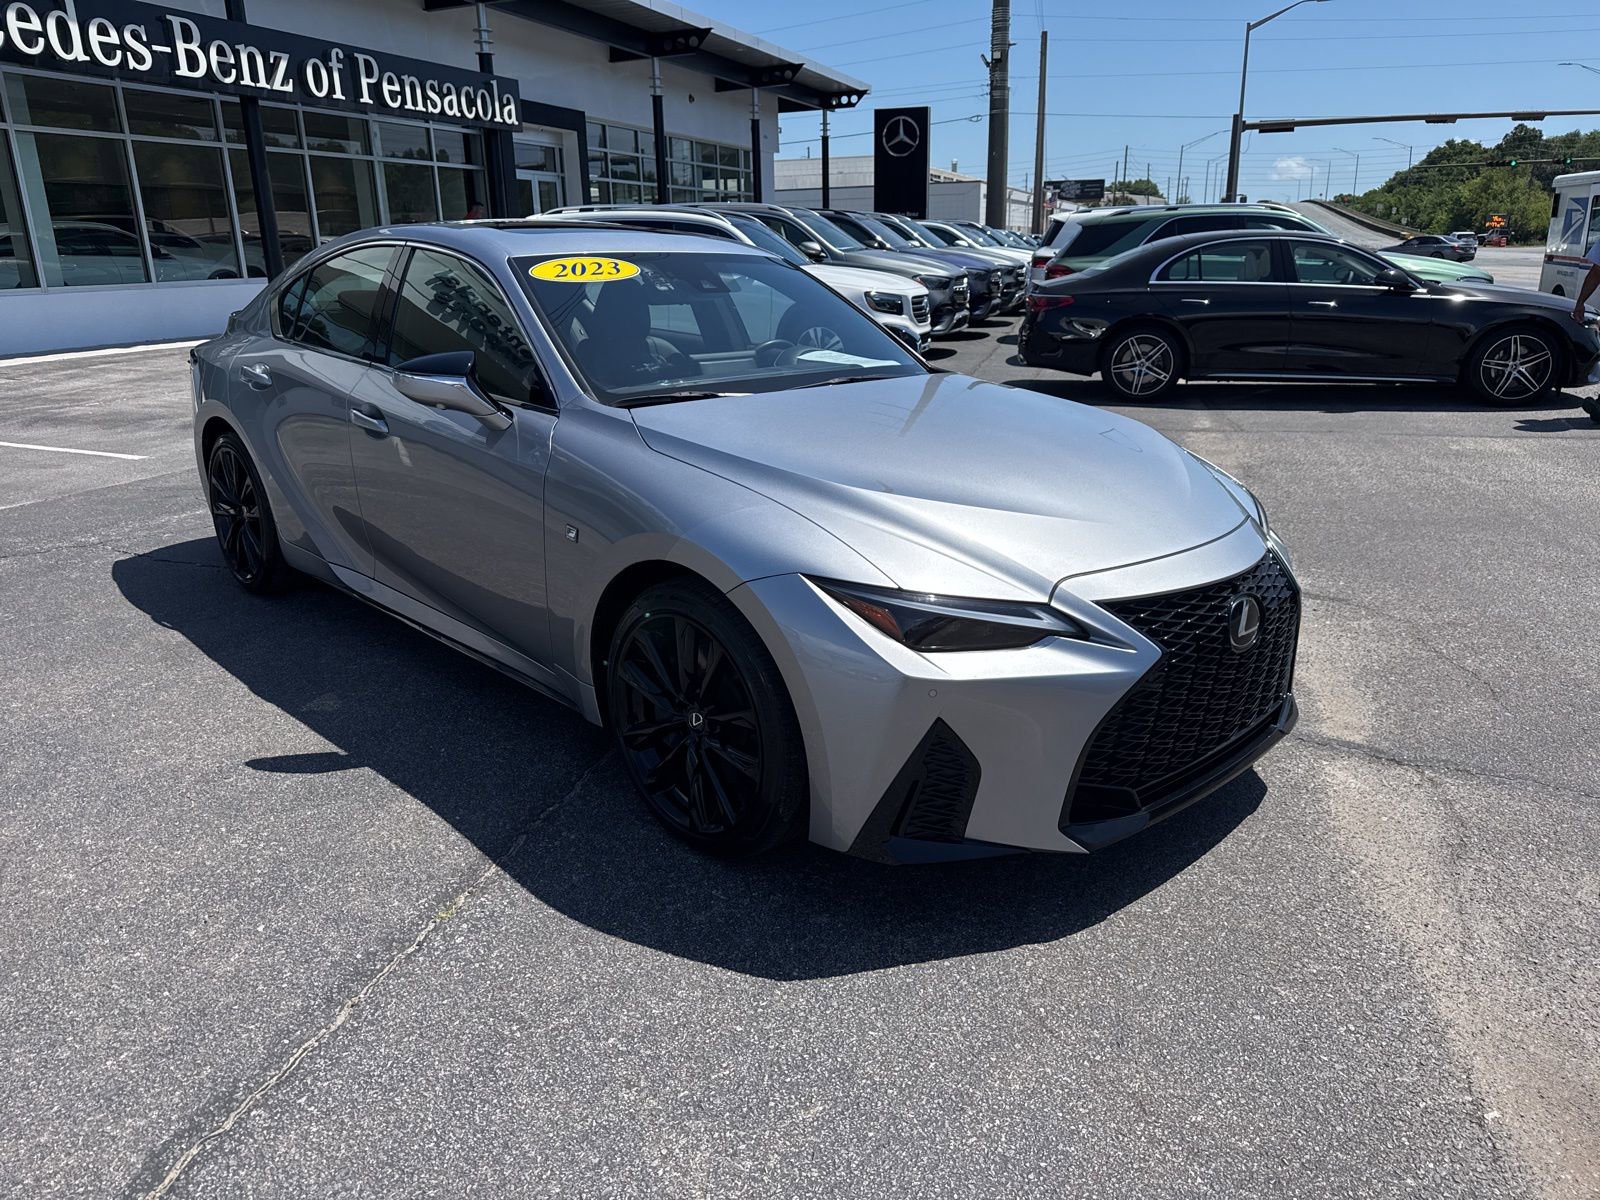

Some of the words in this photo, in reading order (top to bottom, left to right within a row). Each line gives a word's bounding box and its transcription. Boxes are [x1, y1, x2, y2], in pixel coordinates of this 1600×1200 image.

[0, 0, 293, 92] edes-Benz
[306, 48, 346, 100] of
[354, 52, 519, 126] Pensacola
[553, 261, 621, 278] 2023
